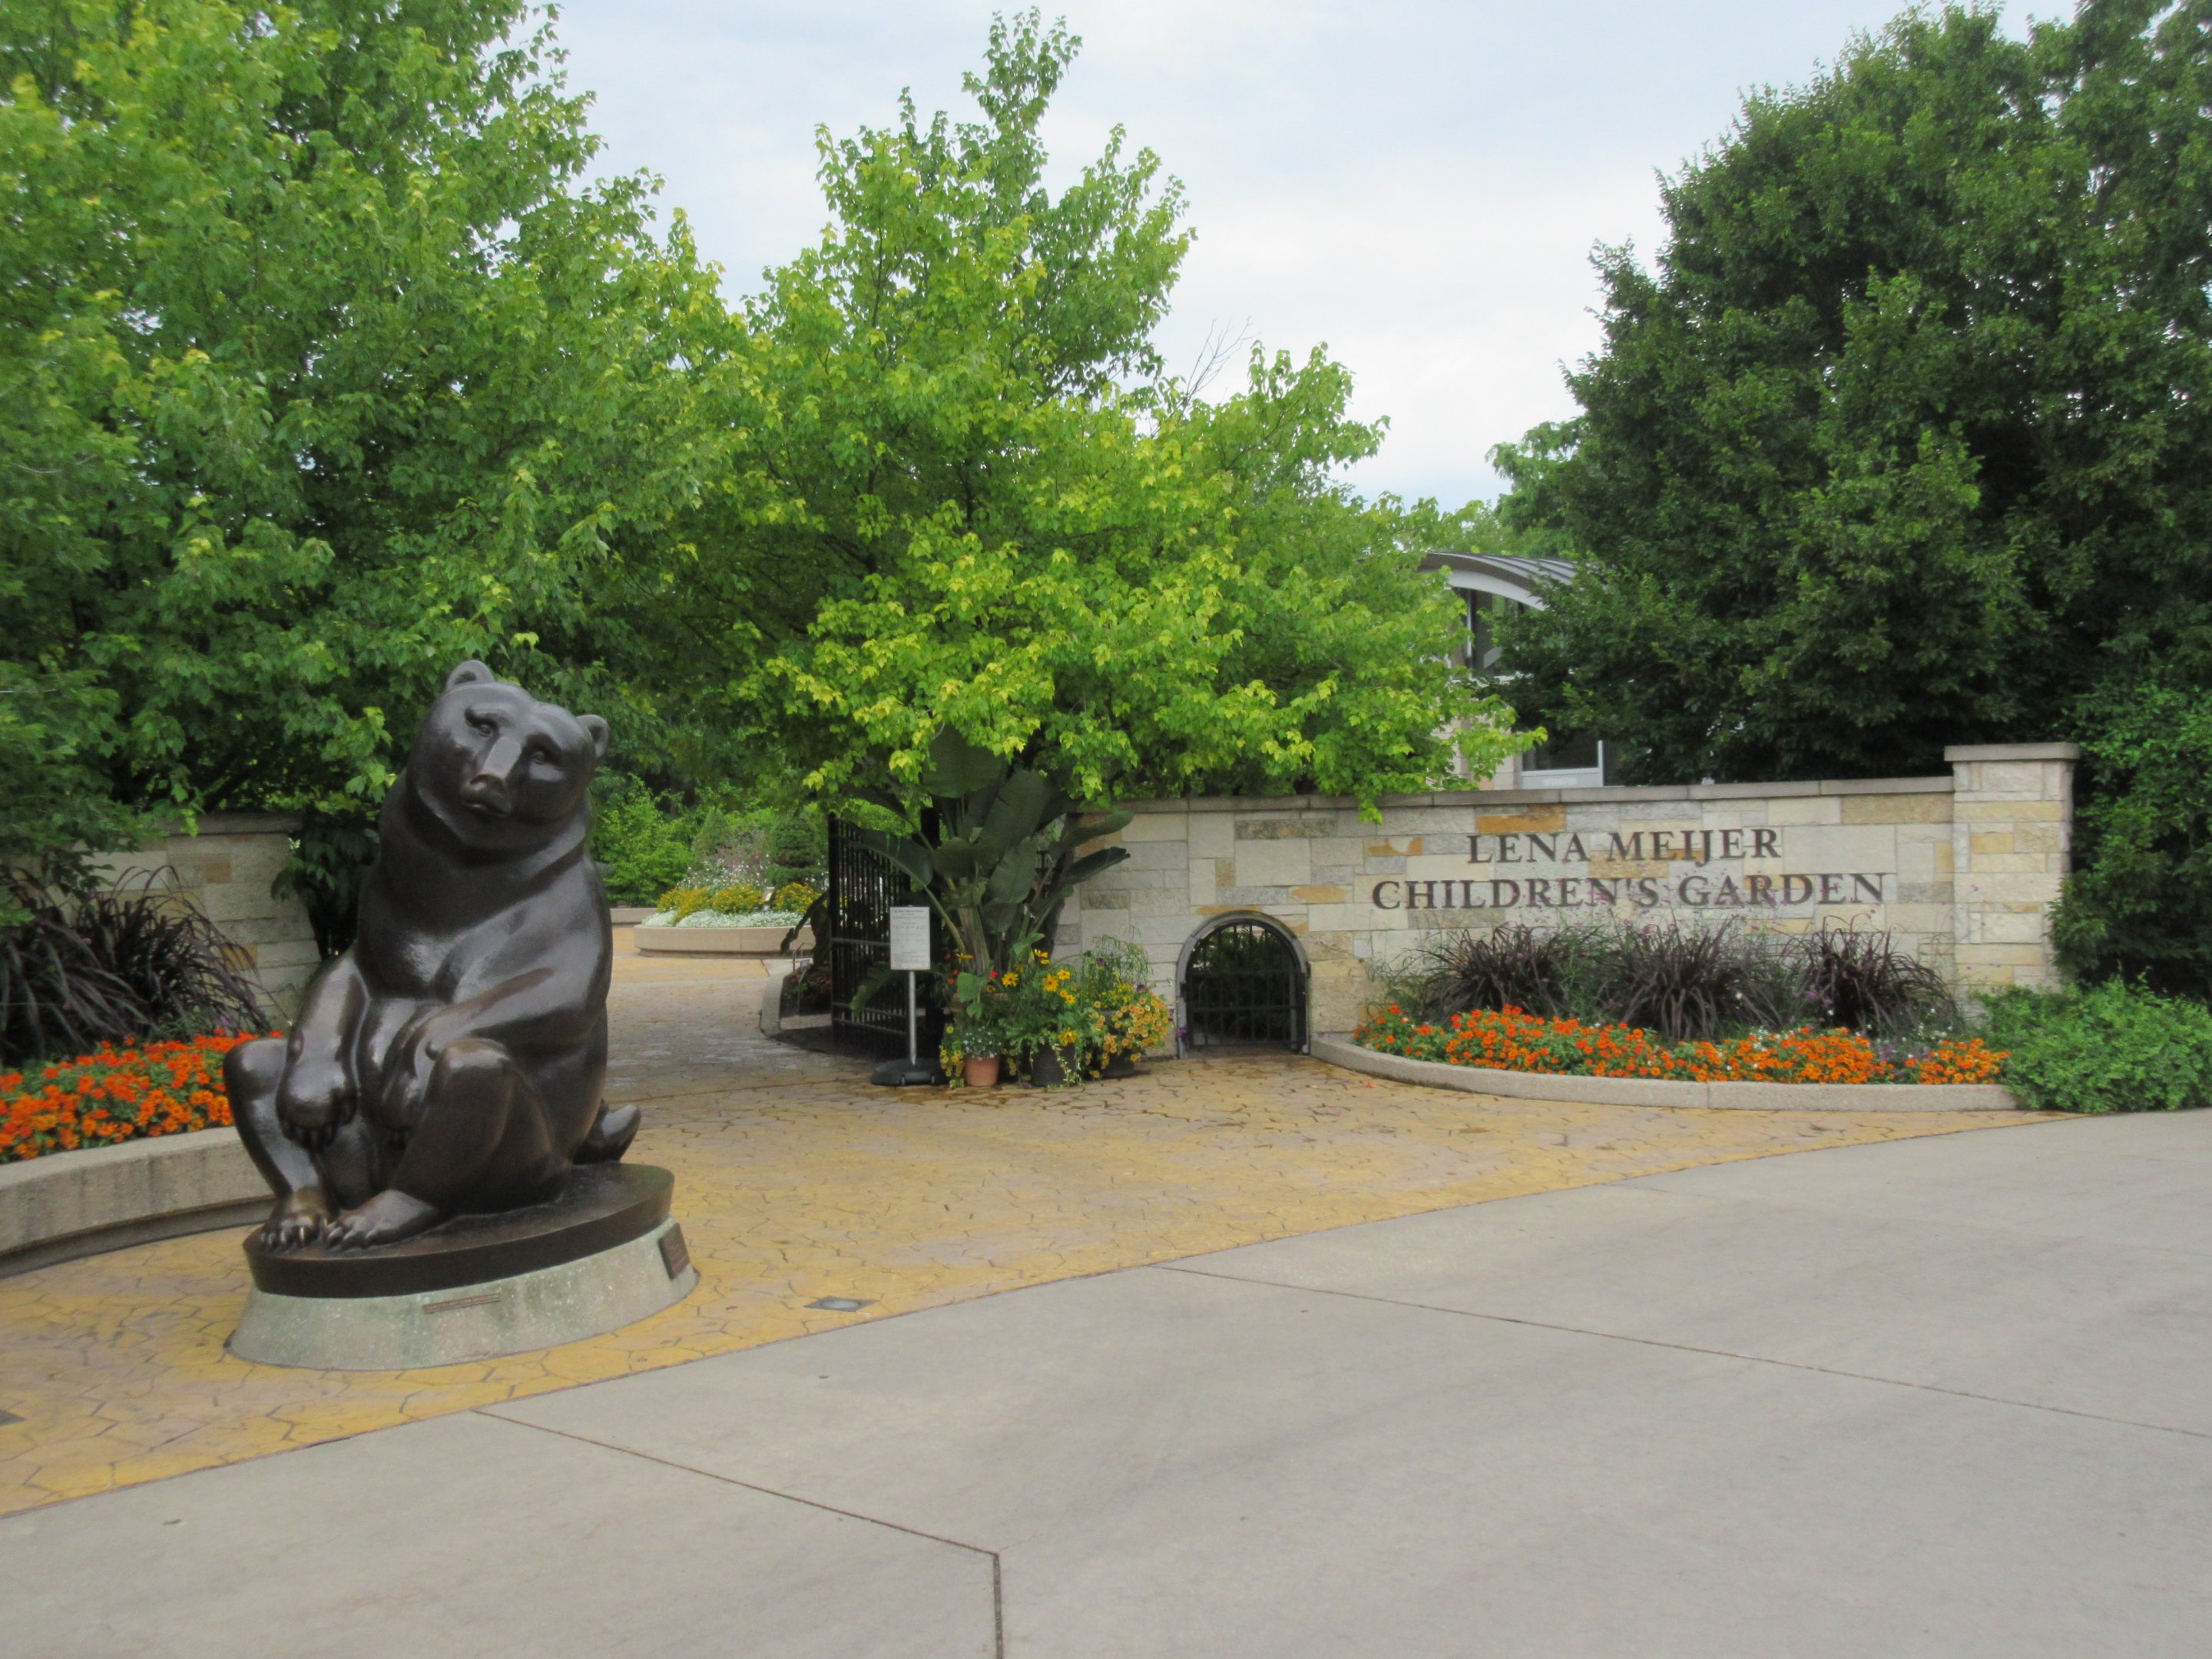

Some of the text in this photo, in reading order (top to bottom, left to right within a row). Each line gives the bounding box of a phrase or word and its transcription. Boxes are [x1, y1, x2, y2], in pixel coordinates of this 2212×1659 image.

[1467, 828, 1781, 867] LENA MEIJER
[1372, 873, 1886, 910] CHILDREN'S GARDEN
